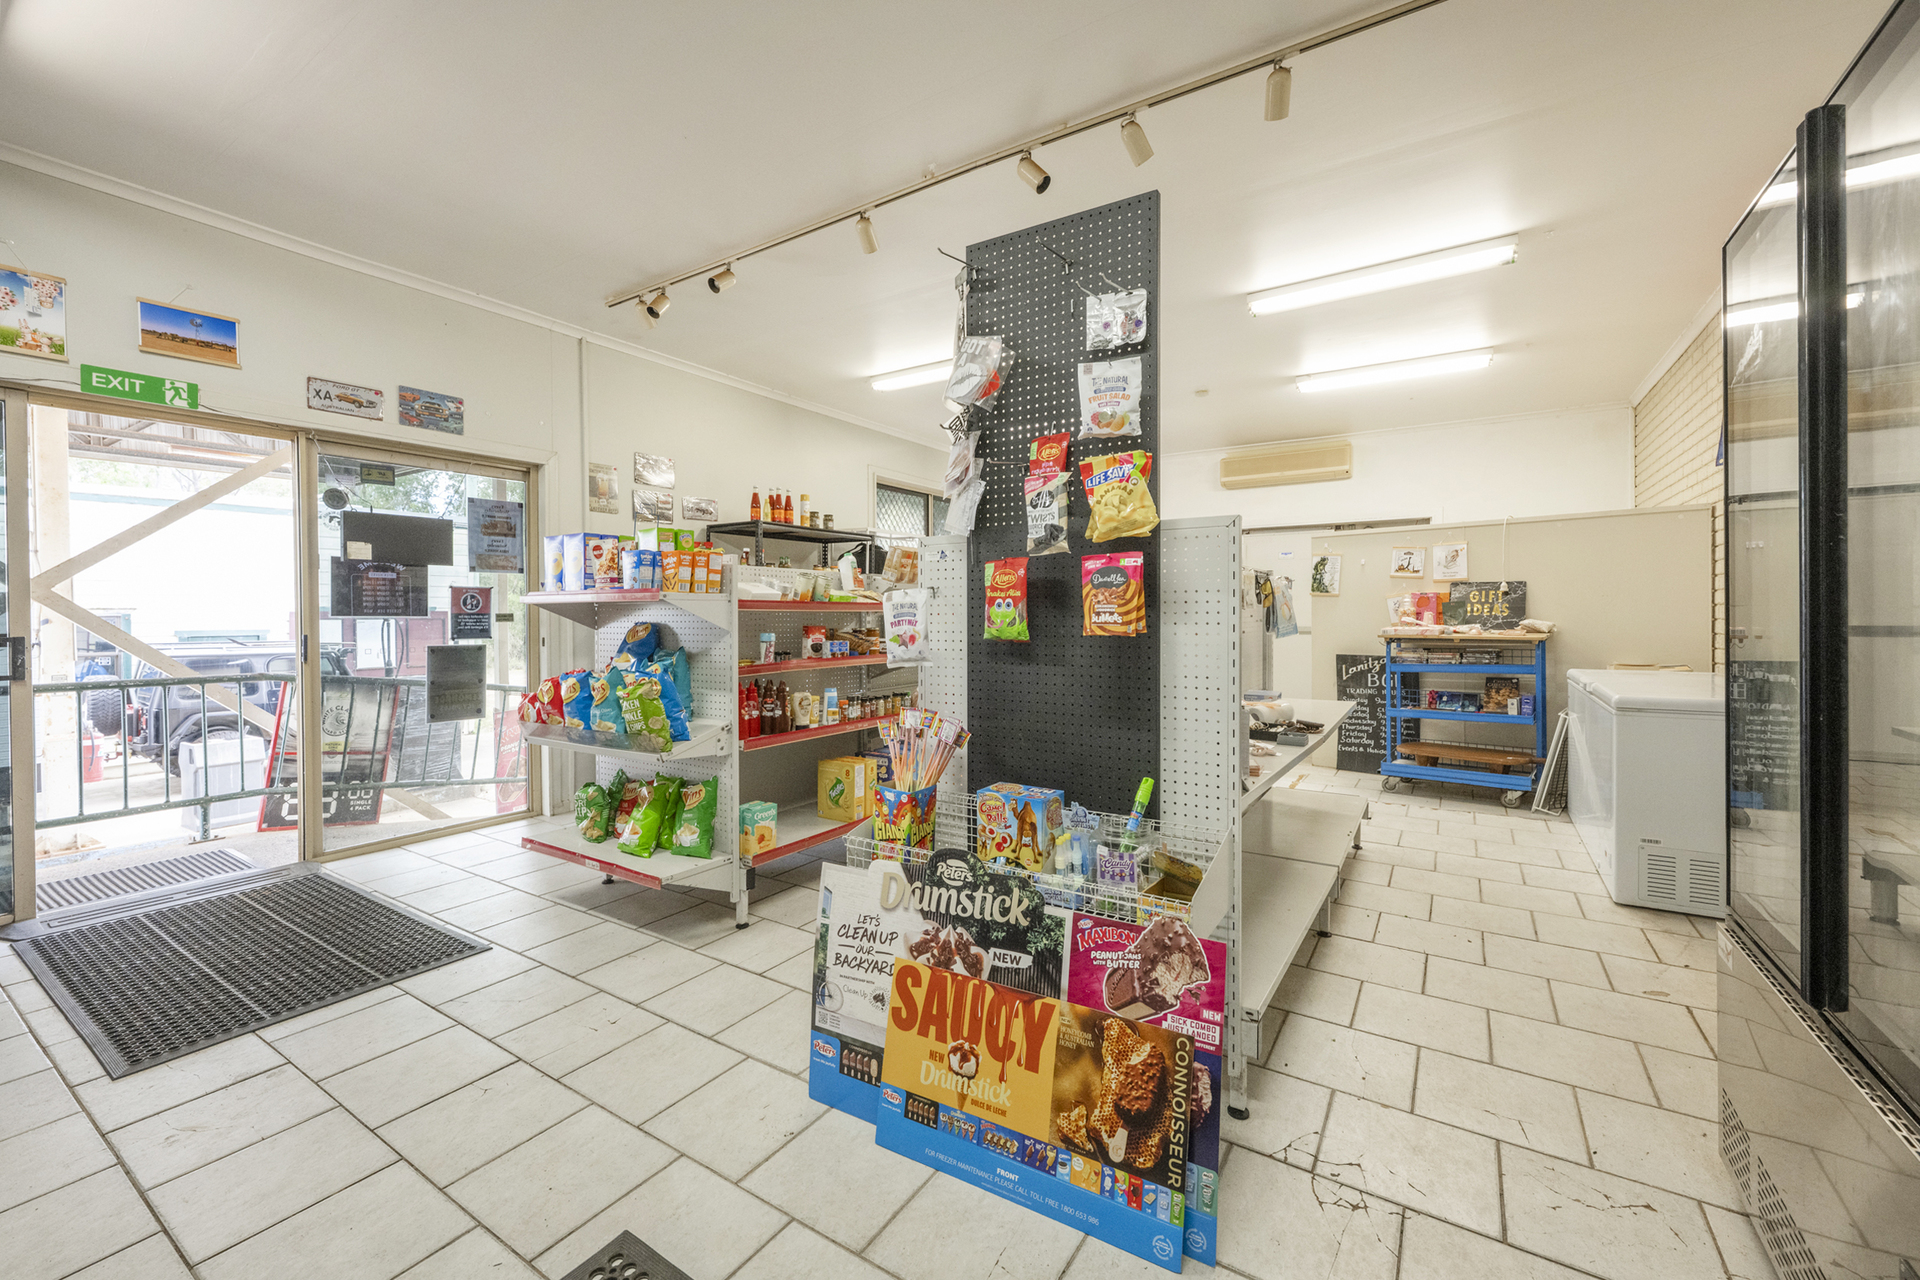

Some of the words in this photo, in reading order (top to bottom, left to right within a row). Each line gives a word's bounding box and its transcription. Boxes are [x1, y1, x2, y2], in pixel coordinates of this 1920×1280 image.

[960, 338, 987, 355] GOT
[957, 353, 967, 367] A
[92, 372, 145, 393] EXIT
[1102, 376, 1129, 385] NATURAL
[332, 384, 350, 392] FORD
[1109, 392, 1131, 401] SALAD
[321, 403, 355, 413] AUSTRALIAN
[1088, 473, 1106, 487] LIFE
[1096, 485, 1134, 505] BANANAS
[994, 573, 1016, 584] Allen's
[1469, 590, 1504, 602] GIFT
[1467, 603, 1509, 616] IDEAS
[890, 619, 907, 628] PARTY
[335, 704, 349, 714] CLA
[1342, 724, 1373, 734] Thursday
[1342, 730, 1367, 741] Friday
[1340, 736, 1374, 748] Saturday
[845, 769, 850, 777] 8
[980, 802, 1006, 814] Camel
[986, 812, 1008, 824] Balls
[875, 821, 906, 841] GIANT
[911, 822, 934, 847] GIANT
[1101, 858, 1132, 870] Candy
[936, 862, 973, 883] Peters
[880, 872, 1031, 927] Drumstick
[857, 914, 881, 927] LET'S
[837, 924, 879, 944] CLEAN
[880, 931, 899, 946] UP
[1077, 926, 1137, 951] MAXIBON
[856, 944, 876, 957] OUR
[1090, 950, 1123, 960] PEANUT
[992, 951, 1022, 966] NEW
[1106, 960, 1140, 969] BUTTER
[843, 984, 860, 996] Clean
[860, 990, 869, 1000] Up
[891, 964, 1056, 1075] SAUCY
[1202, 1010, 1222, 1022] NEW
[1170, 1016, 1188, 1026] SICK
[1190, 1020, 1216, 1034] COMBO
[1060, 1025, 1092, 1040] HONEYCOMB
[1059, 1039, 1077, 1050] HONEY
[1064, 1034, 1095, 1048] AUSTRALIAN
[1195, 1042, 1216, 1052] DIFFERENT
[813, 1040, 836, 1058] Peters
[928, 1049, 945, 1064] NEW
[920, 1060, 1012, 1107] Drumstick
[882, 1088, 903, 1104] Peters
[970, 1098, 986, 1111] DULCE
[985, 1103, 992, 1112] DE
[992, 1106, 1007, 1118] LECHE
[1167, 1037, 1190, 1188] CONNOISSEUR
[996, 1167, 1020, 1182] FRONT
[924, 1148, 936, 1156] FOR
[936, 1152, 958, 1166] FREEZER
[957, 1160, 994, 1182] MAINTENANCE
[994, 1175, 1014, 1190] PLEASE
[1014, 1184, 1029, 1196] CALL
[1029, 1191, 1044, 1203] TOLL
[1045, 1197, 1060, 1209] FREE
[1060, 1204, 1075, 1215] 1800
[1075, 1210, 1087, 1221] 653
[1088, 1215, 1100, 1226] 986
